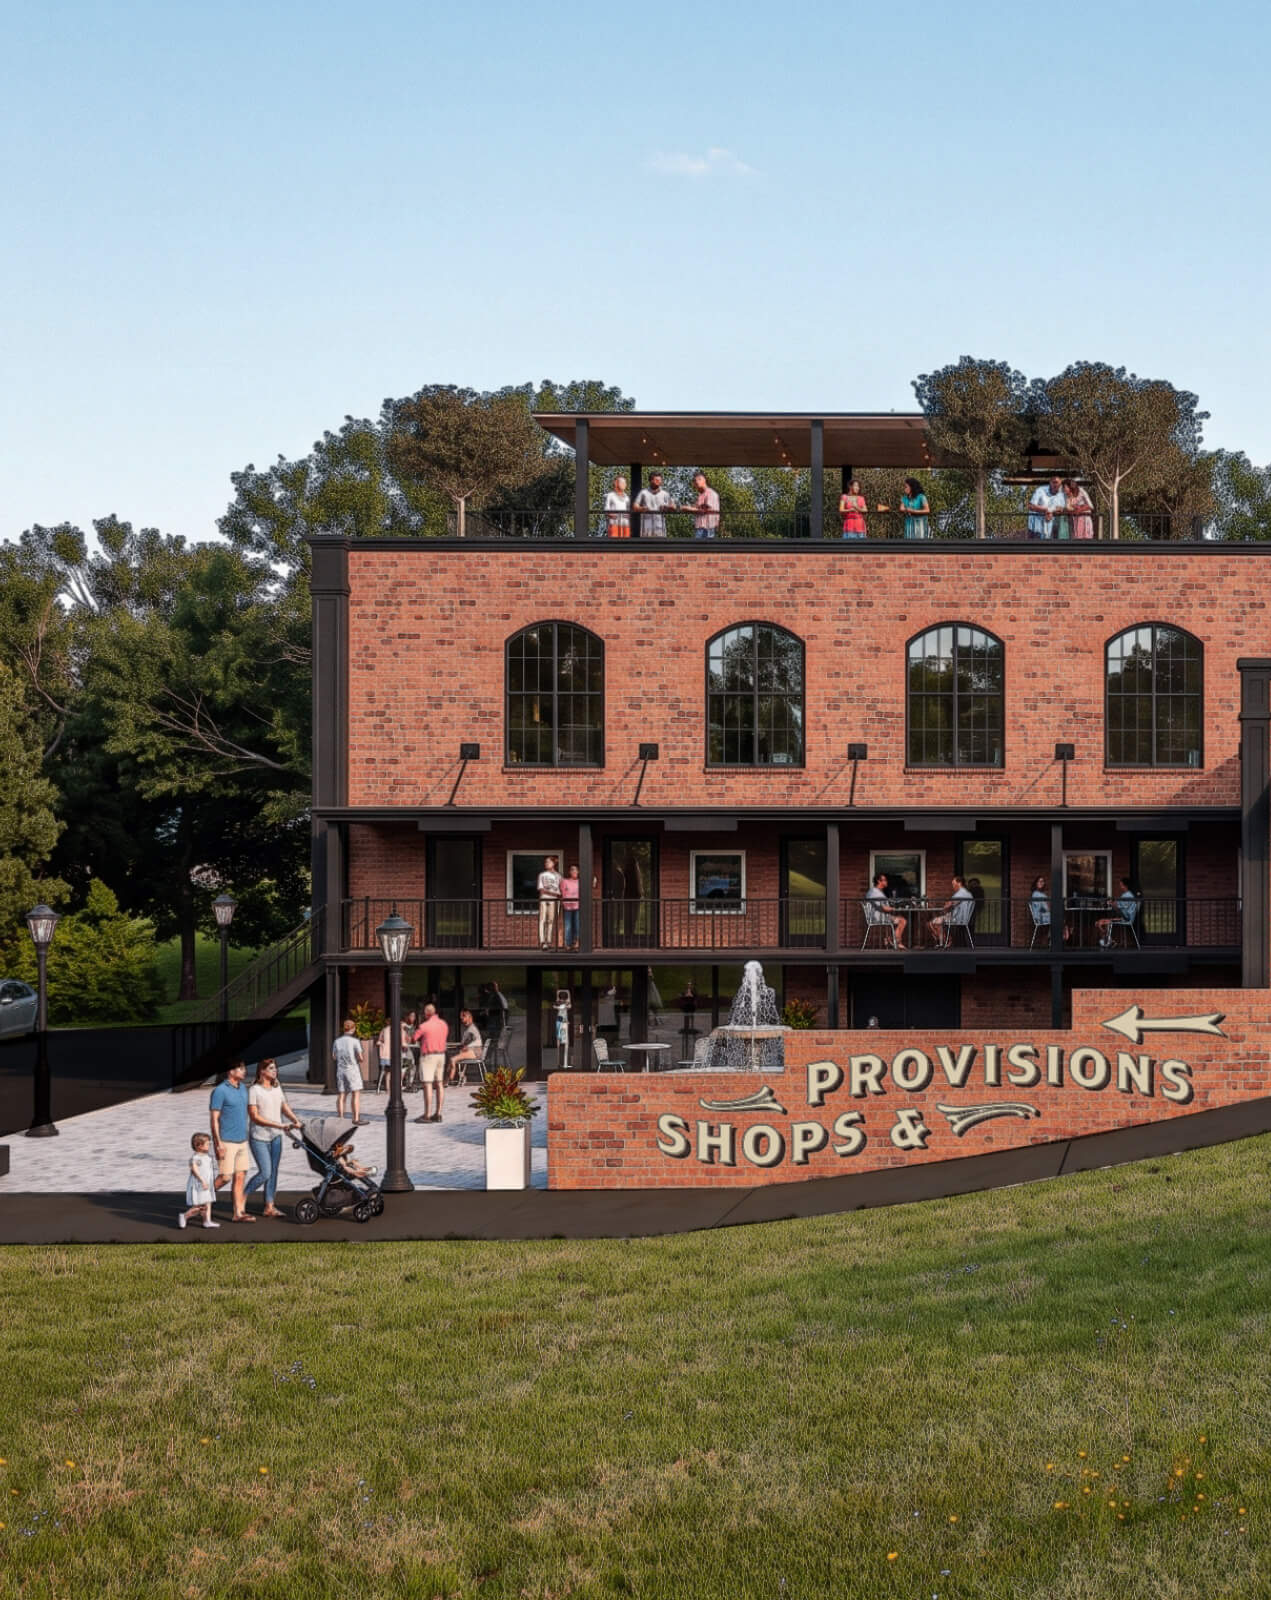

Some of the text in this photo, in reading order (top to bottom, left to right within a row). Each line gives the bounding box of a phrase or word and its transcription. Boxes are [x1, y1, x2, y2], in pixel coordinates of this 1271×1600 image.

[806, 1043, 1195, 1107] PROVISIONS
[656, 1107, 930, 1168] SHOPS &
